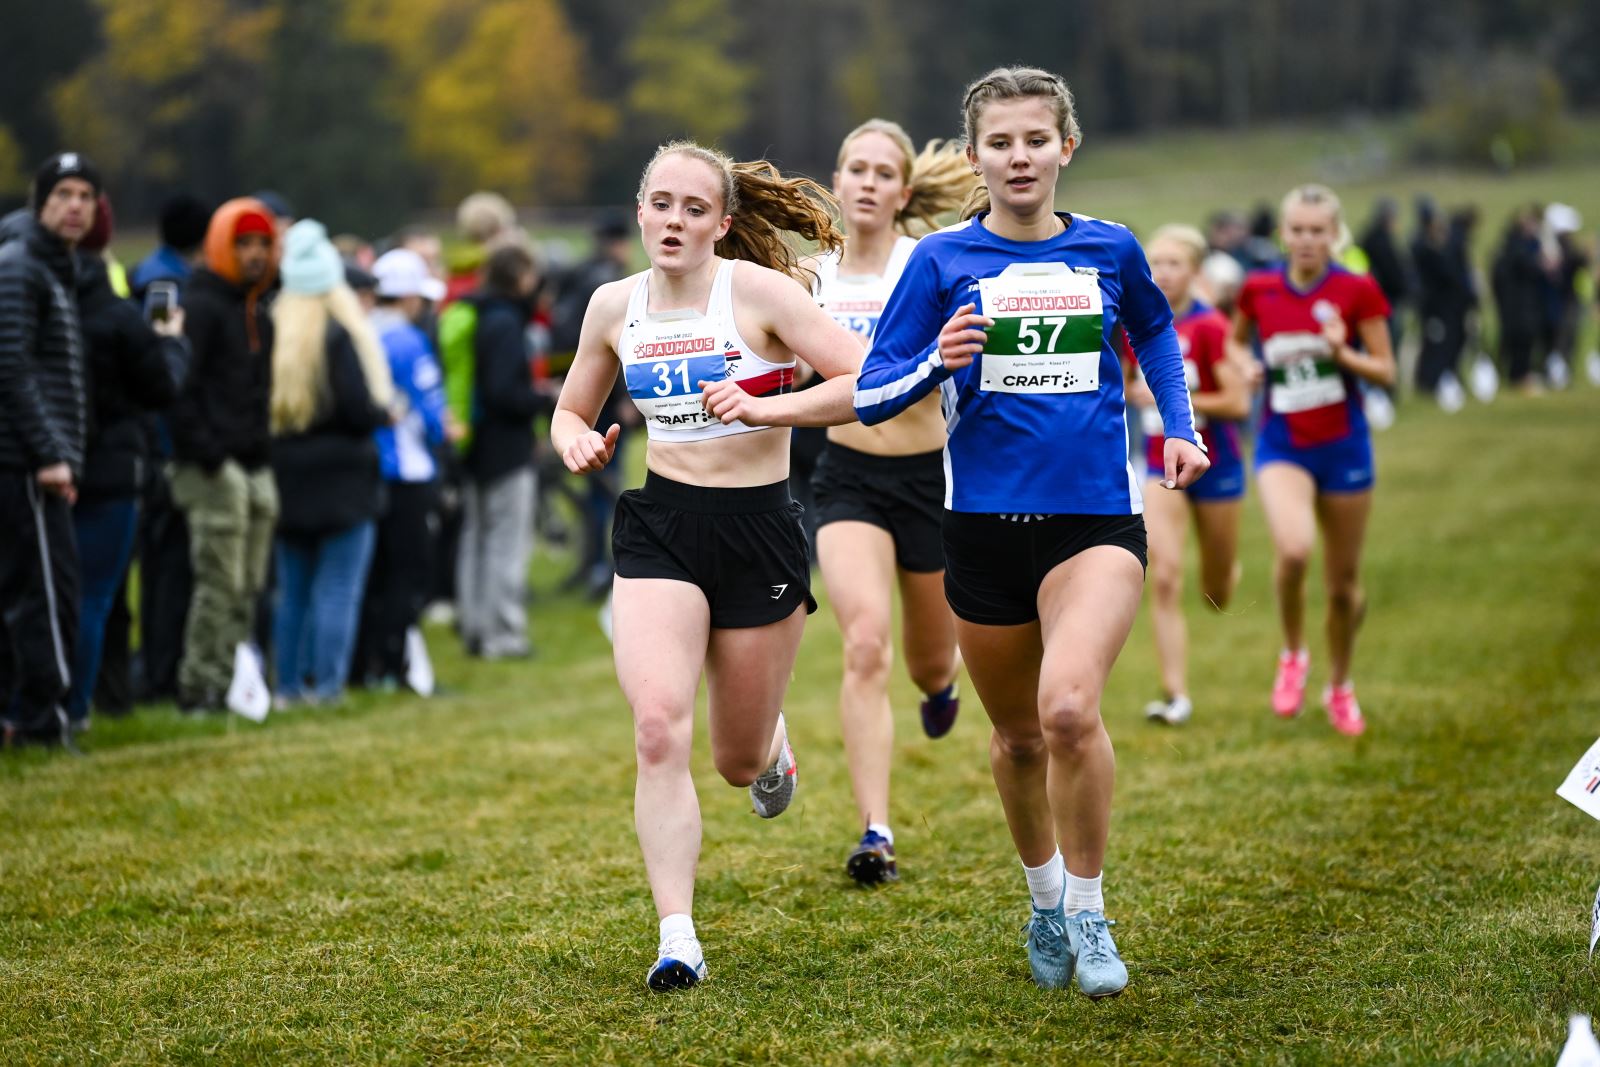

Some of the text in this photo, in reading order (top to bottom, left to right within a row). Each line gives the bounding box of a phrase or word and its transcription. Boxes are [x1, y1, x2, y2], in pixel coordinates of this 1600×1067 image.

[1008, 295, 1090, 311] BAUHAUS
[1017, 316, 1067, 354] 57
[646, 337, 714, 357] BAUHAUS
[651, 359, 691, 397] 31
[1003, 375, 1062, 386] CRAFT
[656, 412, 699, 424] CRAFT
